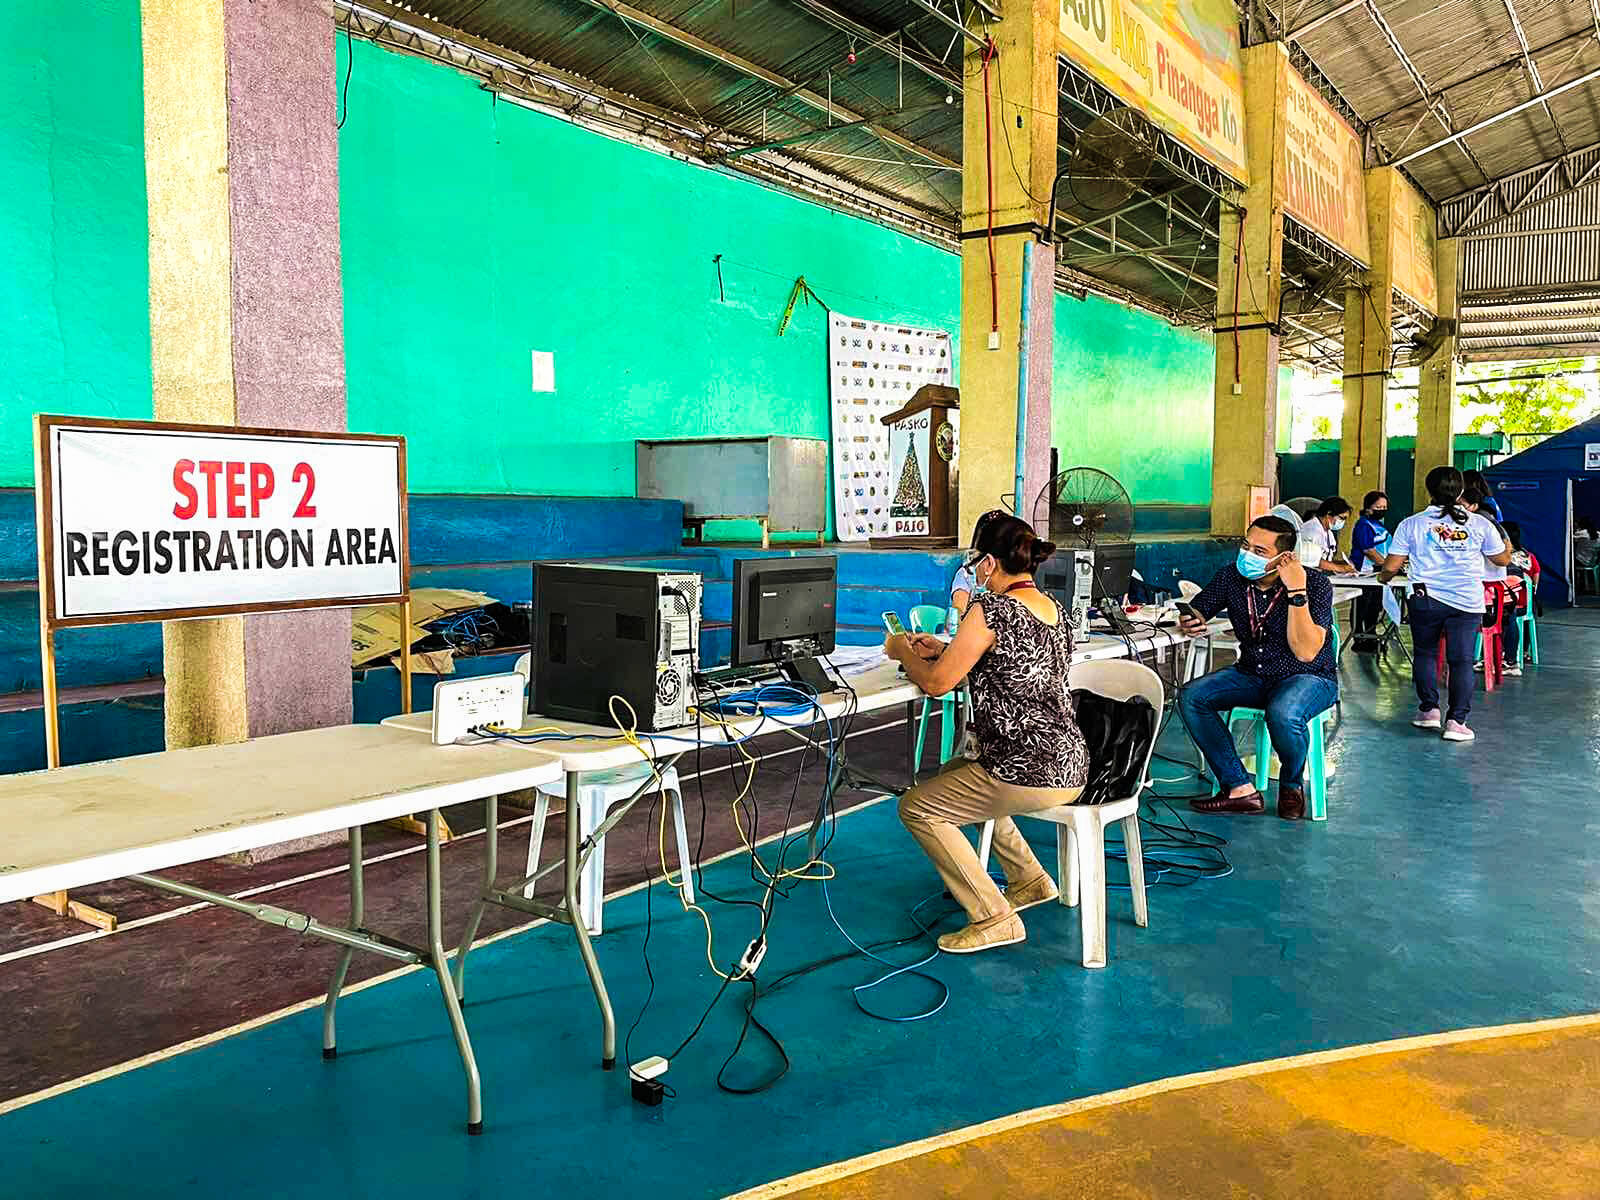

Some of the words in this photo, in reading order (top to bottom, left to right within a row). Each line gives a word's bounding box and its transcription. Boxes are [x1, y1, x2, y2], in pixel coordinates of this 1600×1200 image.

[1156, 40, 1219, 138] Pinangga
[894, 417, 929, 431] PASKO
[173, 459, 275, 520] STEP
[291, 462, 317, 519] 2
[66, 529, 314, 576] REGISTRATION
[325, 527, 397, 566] AREA
